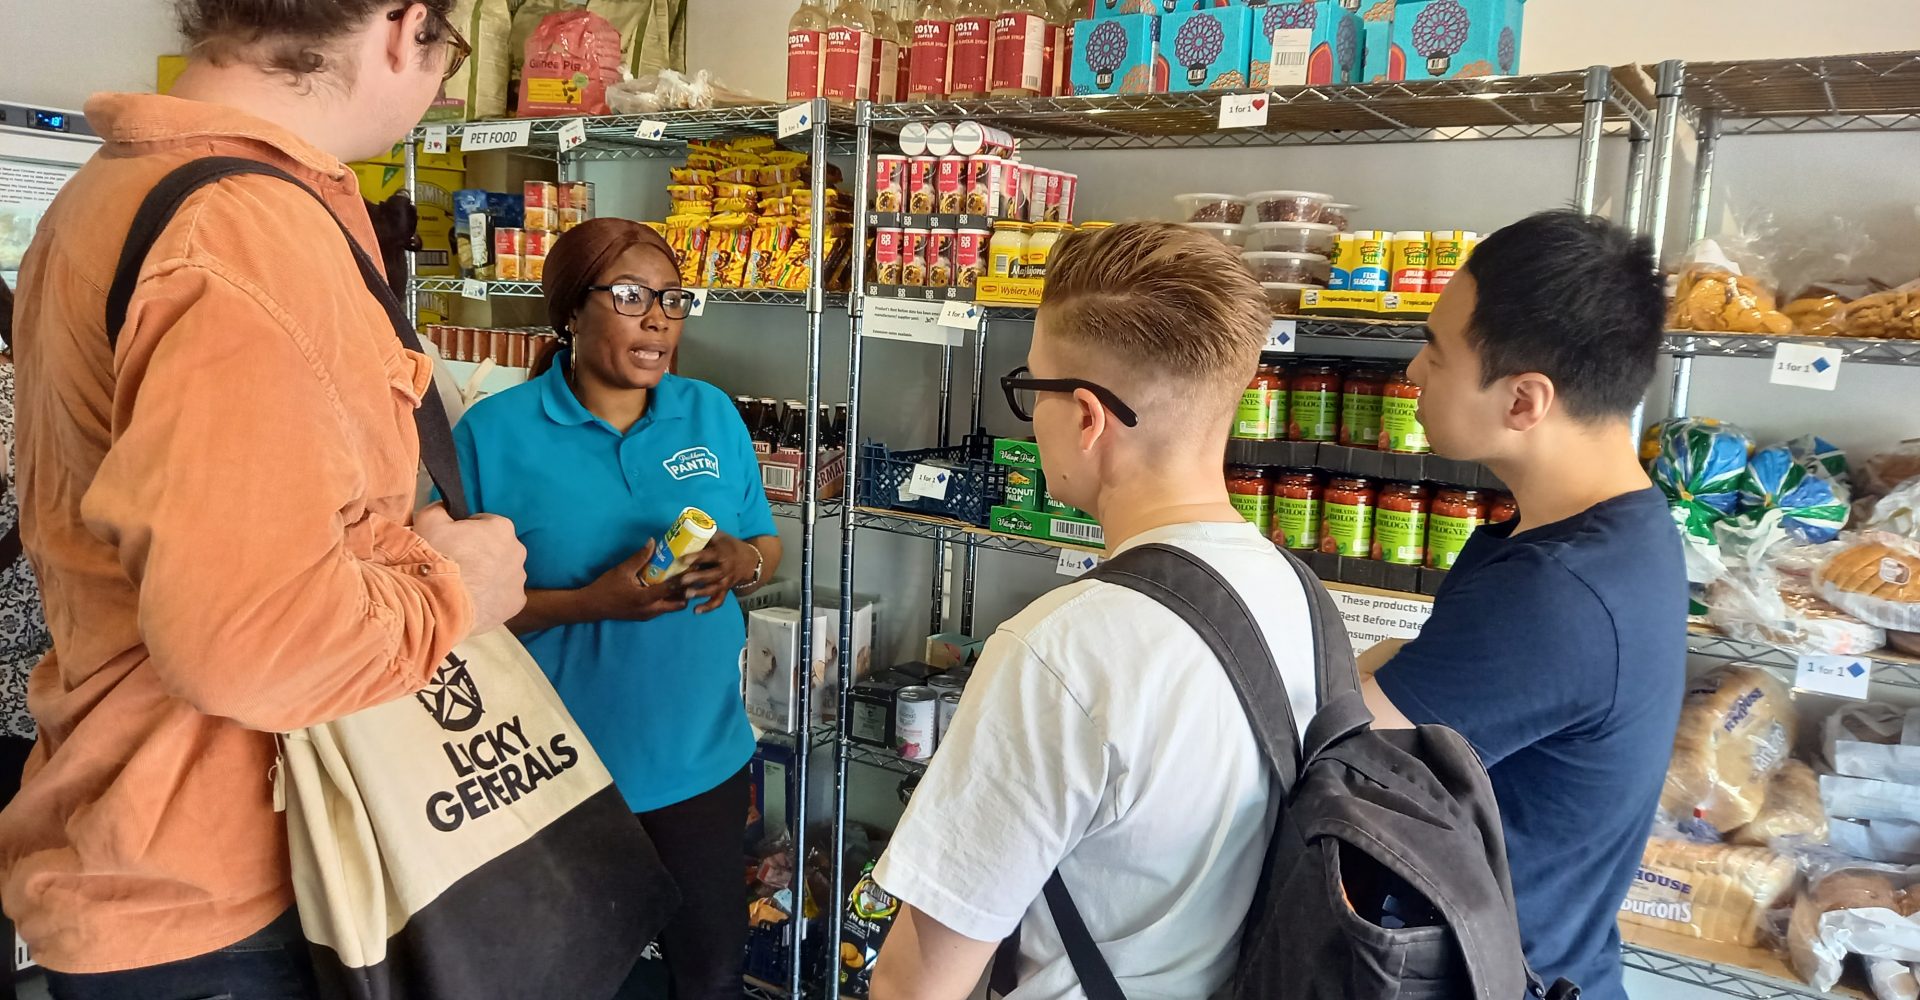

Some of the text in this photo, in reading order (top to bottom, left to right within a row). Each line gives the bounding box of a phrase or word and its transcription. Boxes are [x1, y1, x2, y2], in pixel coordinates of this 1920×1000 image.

[914, 24, 940, 34] COSTA
[954, 22, 980, 32] COSTA
[788, 34, 810, 44] COSTA
[828, 32, 851, 40] COSTA
[470, 131, 518, 144] PET FOOD
[427, 142, 432, 150] 3
[566, 140, 570, 148] 2
[1364, 256, 1381, 264] SUN
[1408, 256, 1426, 264] SUN
[1438, 256, 1456, 264] SUN
[1270, 337, 1276, 346] 1
[1786, 362, 1802, 371] for
[1803, 364, 1809, 372] 1
[1000, 450, 1036, 464] Village Pride
[670, 458, 716, 474] PANTRY
[1007, 494, 1024, 502] MILK
[1048, 500, 1065, 508] MILK
[997, 518, 1016, 530] Village
[1060, 558, 1064, 566] 1
[1076, 561, 1082, 569] 1
[1341, 594, 1370, 607] These
[1372, 600, 1418, 614] products
[1362, 614, 1396, 627] Before
[1806, 662, 1845, 677] 1 for 1
